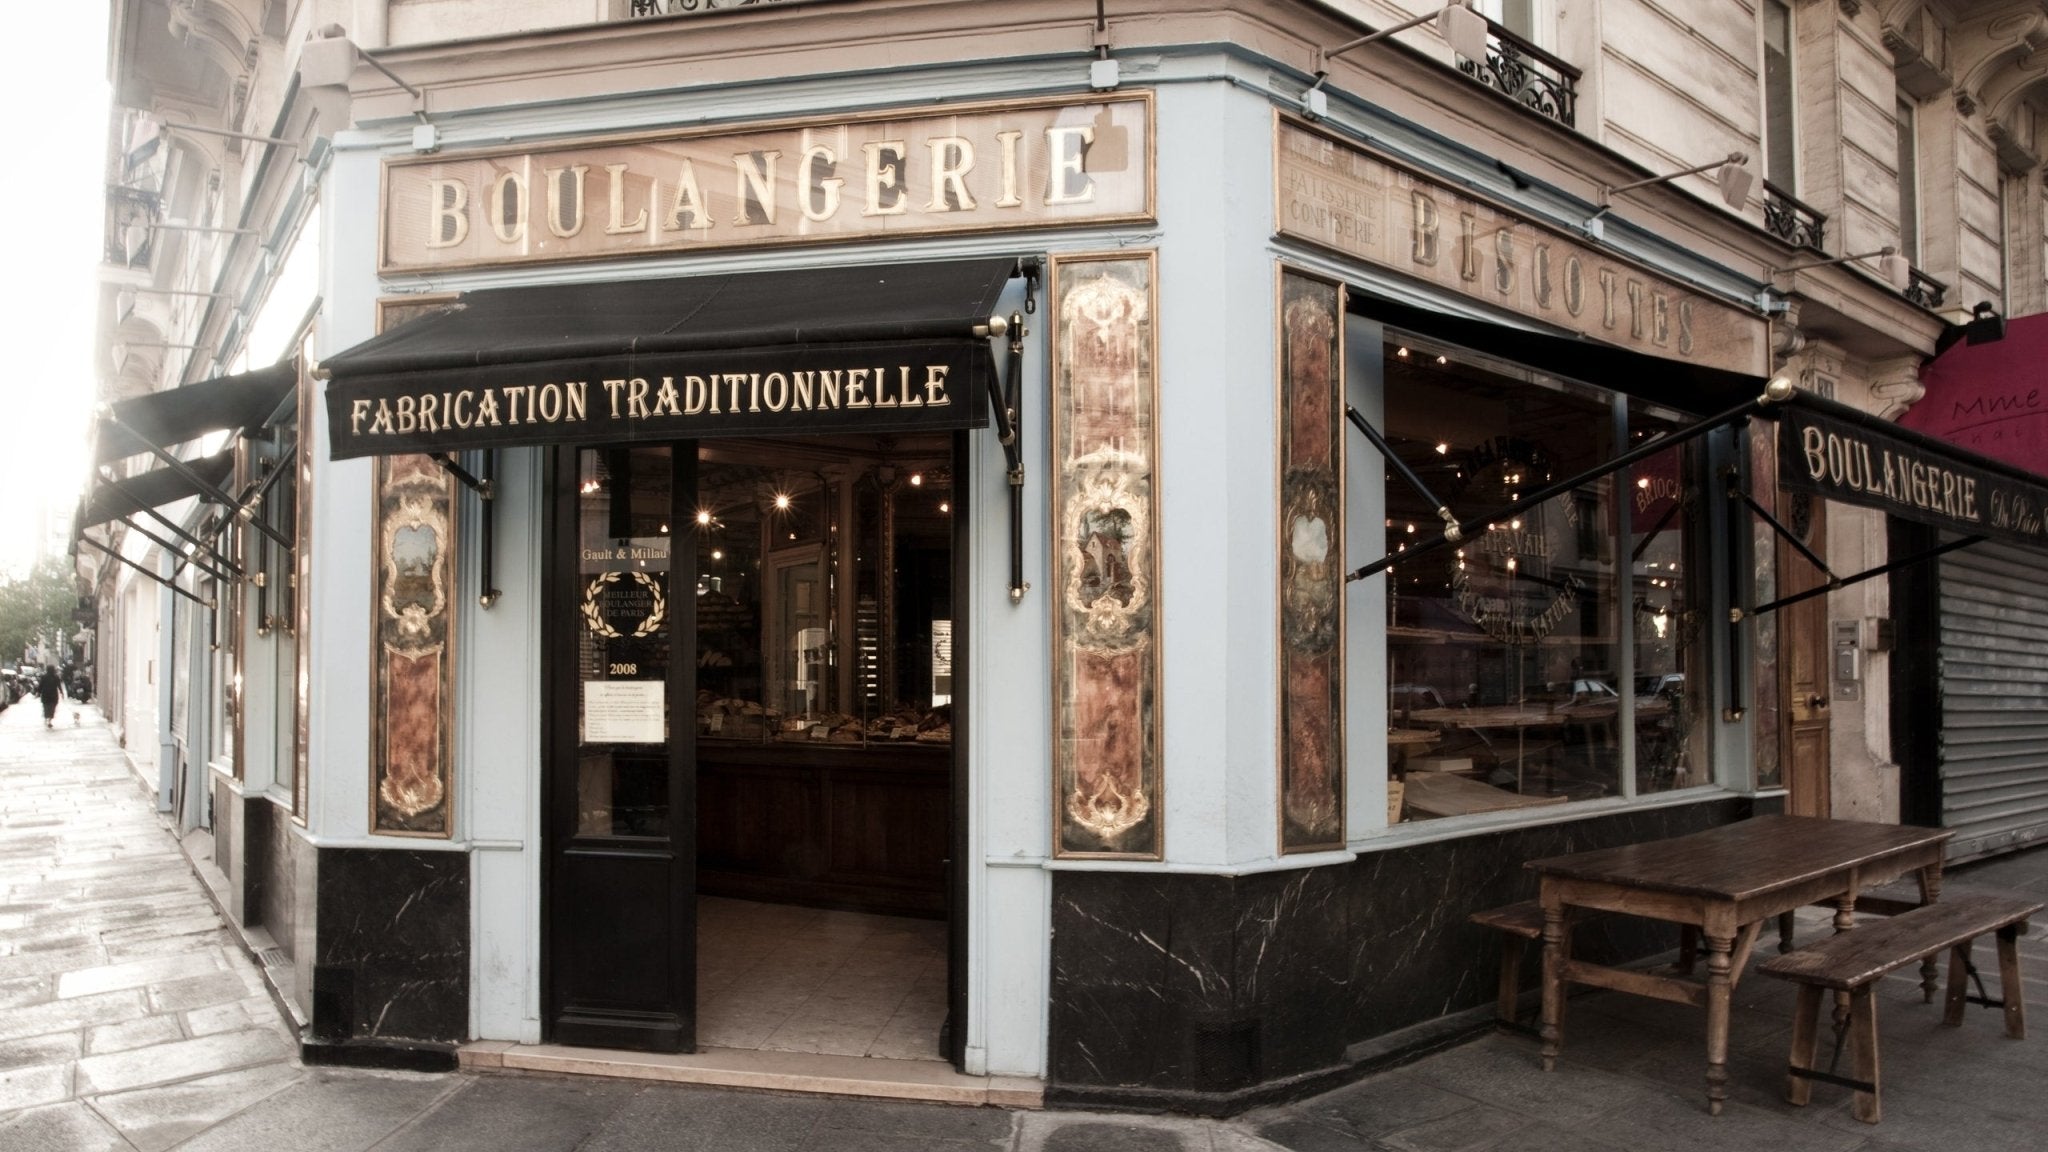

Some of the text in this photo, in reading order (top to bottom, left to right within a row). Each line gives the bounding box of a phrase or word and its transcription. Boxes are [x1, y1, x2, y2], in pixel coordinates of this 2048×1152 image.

[426, 124, 1097, 249] BOULANGERIE
[1290, 199, 1377, 246] CONFISERIE
[1411, 189, 1694, 356] BISCOTTES
[351, 364, 952, 437] FABRICATION TRADITIONNELLE
[1952, 388, 2041, 420] Mme
[1803, 425, 1981, 522] BOULANGERIE
[582, 548, 667, 560] Gault & Millau
[603, 591, 649, 599] MEILLEUR
[621, 609, 645, 617] PARIS
[609, 663, 638, 675] 2008
